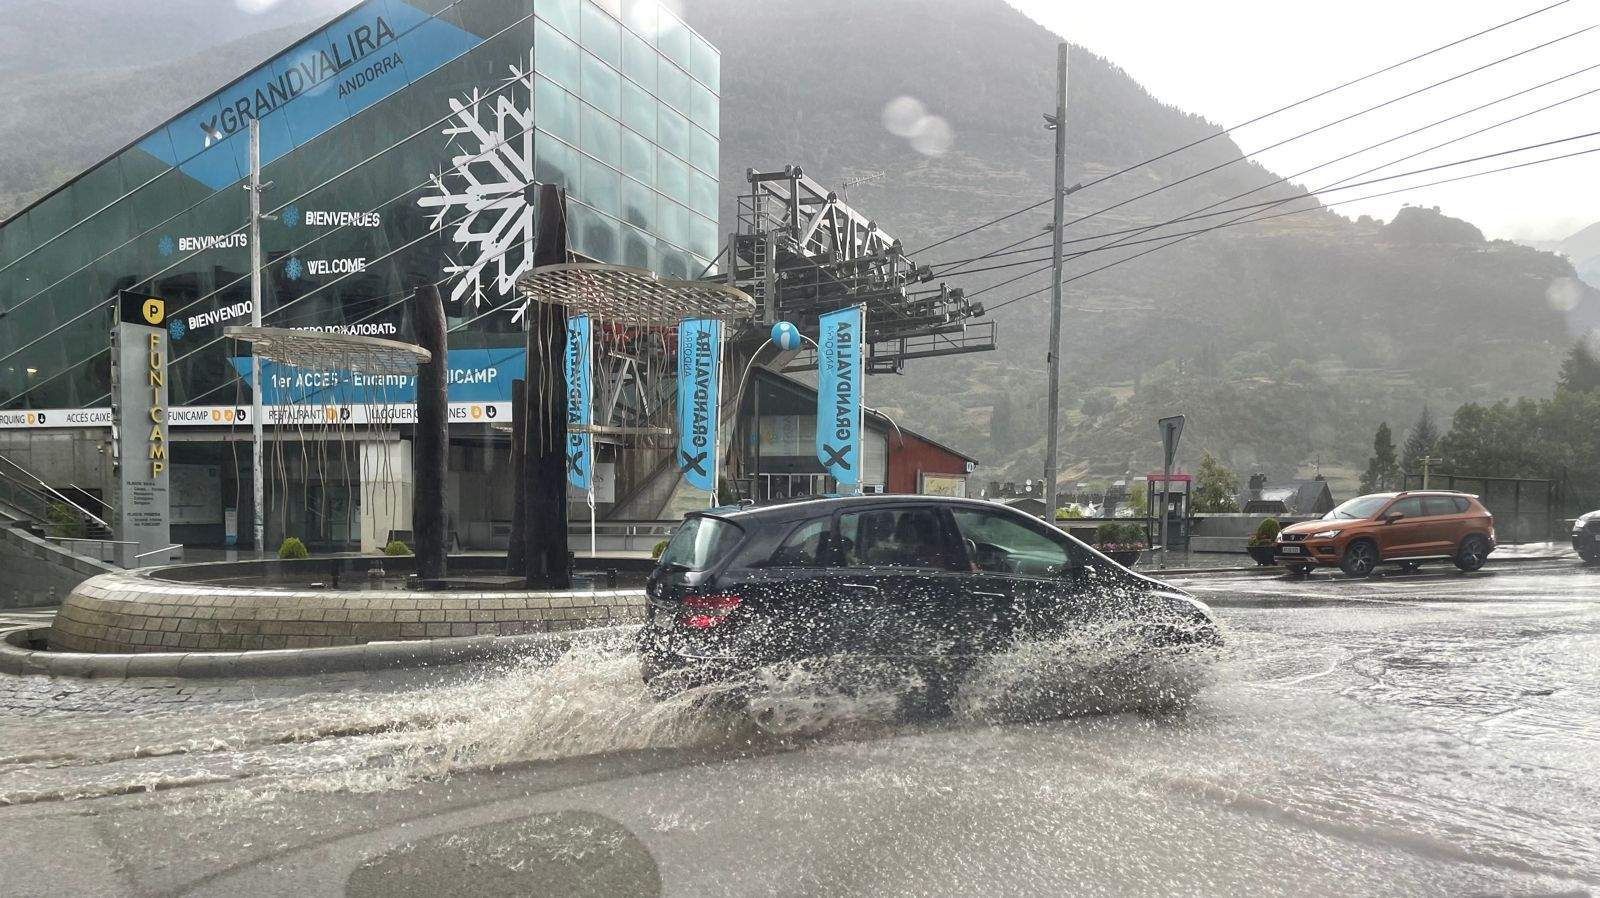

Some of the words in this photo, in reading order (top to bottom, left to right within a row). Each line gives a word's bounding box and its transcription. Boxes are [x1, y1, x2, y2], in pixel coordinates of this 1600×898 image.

[221, 16, 395, 134] GRANDVALIRA
[338, 52, 403, 99] ANDORRA
[305, 211, 380, 227] BIENVENUES
[179, 233, 247, 251] BENVINGUTS
[307, 257, 366, 275] WELCOME
[272, 374, 291, 388] 1er
[149, 332, 166, 479] FUNICAMP
[90, 412, 112, 422] CAIXE
[168, 411, 208, 421] FUNICAMP
